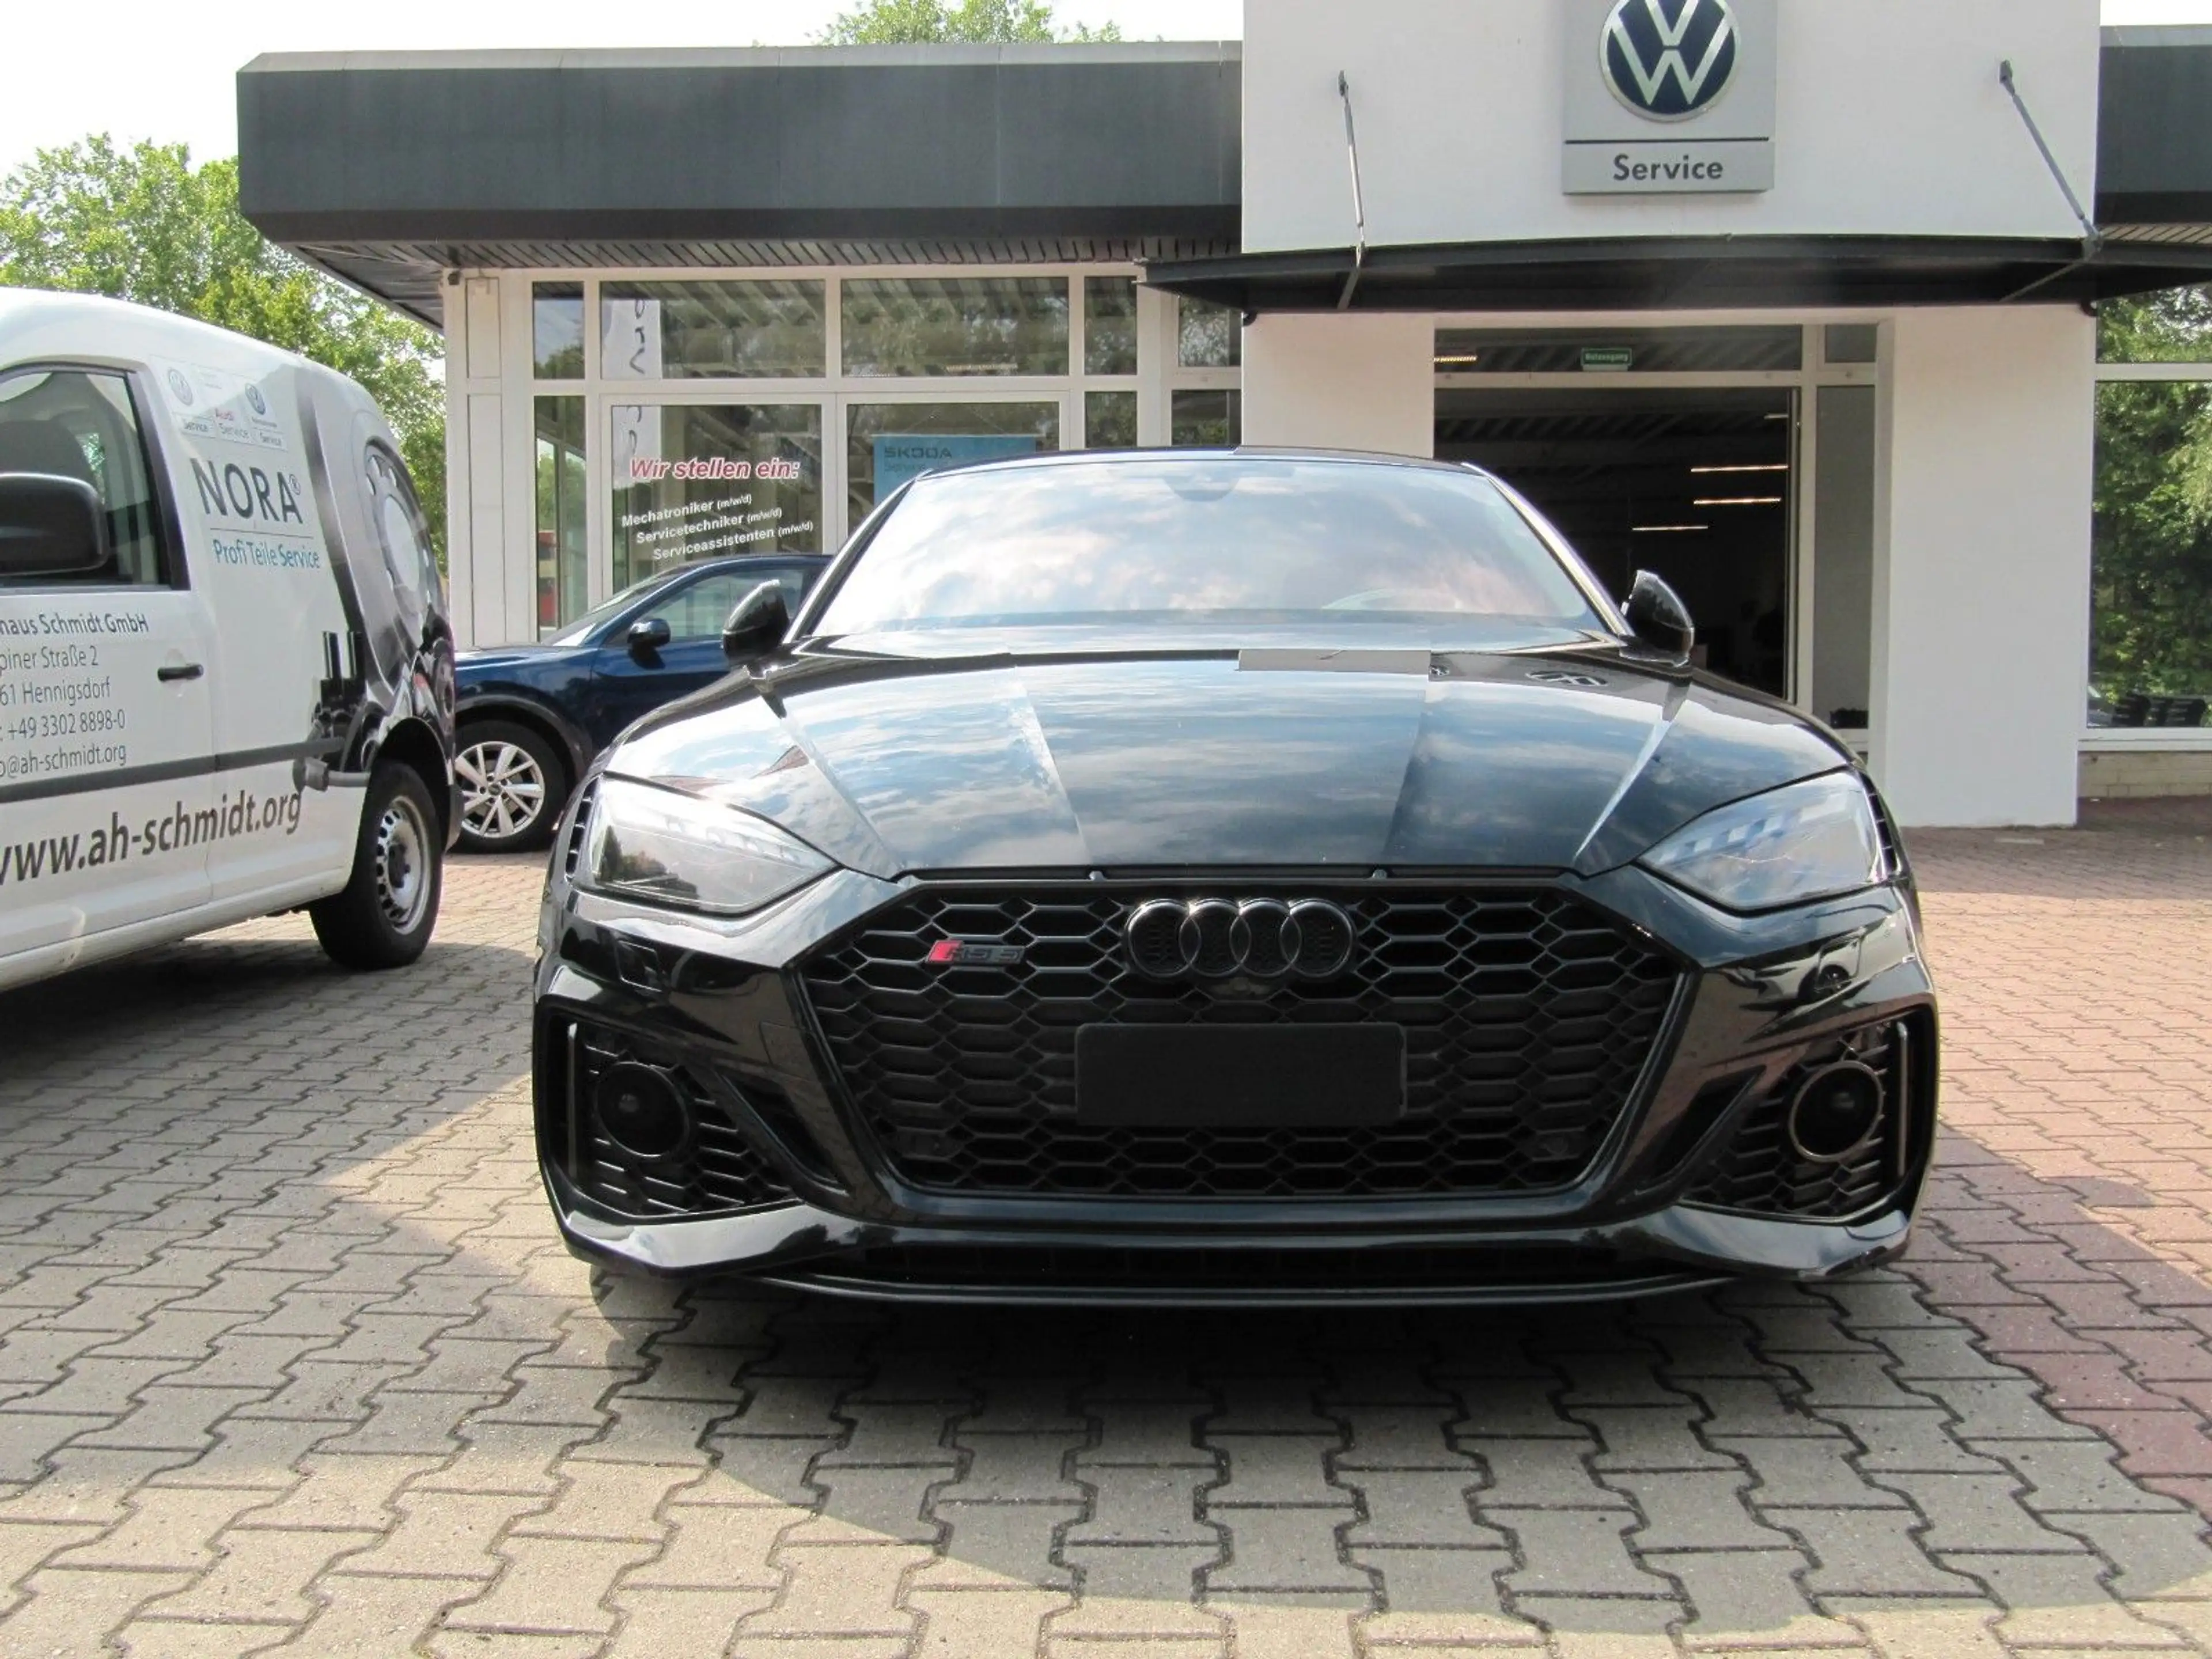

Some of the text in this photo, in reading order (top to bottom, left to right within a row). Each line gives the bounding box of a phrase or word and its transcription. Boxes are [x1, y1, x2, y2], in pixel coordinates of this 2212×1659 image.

[1612, 154, 1724, 180] Service
[630, 456, 800, 479] Wir stellen ein:
[622, 493, 752, 528] Mechatroniker (m/w/d)
[636, 507, 782, 544] Servicetechniker (m/w/d)
[213, 539, 320, 569] Profi Teile Service
[653, 521, 814, 560] Serviceassistenten (m/w/d)
[39, 612, 105, 635] Schmidt
[104, 613, 149, 634] GmbH
[41, 644, 87, 669] Straße
[89, 645, 99, 666] 2
[22, 676, 111, 707] Hennigsdorf
[7, 717, 37, 741] +49
[41, 713, 77, 737] 3302
[79, 709, 126, 733] 8898-0
